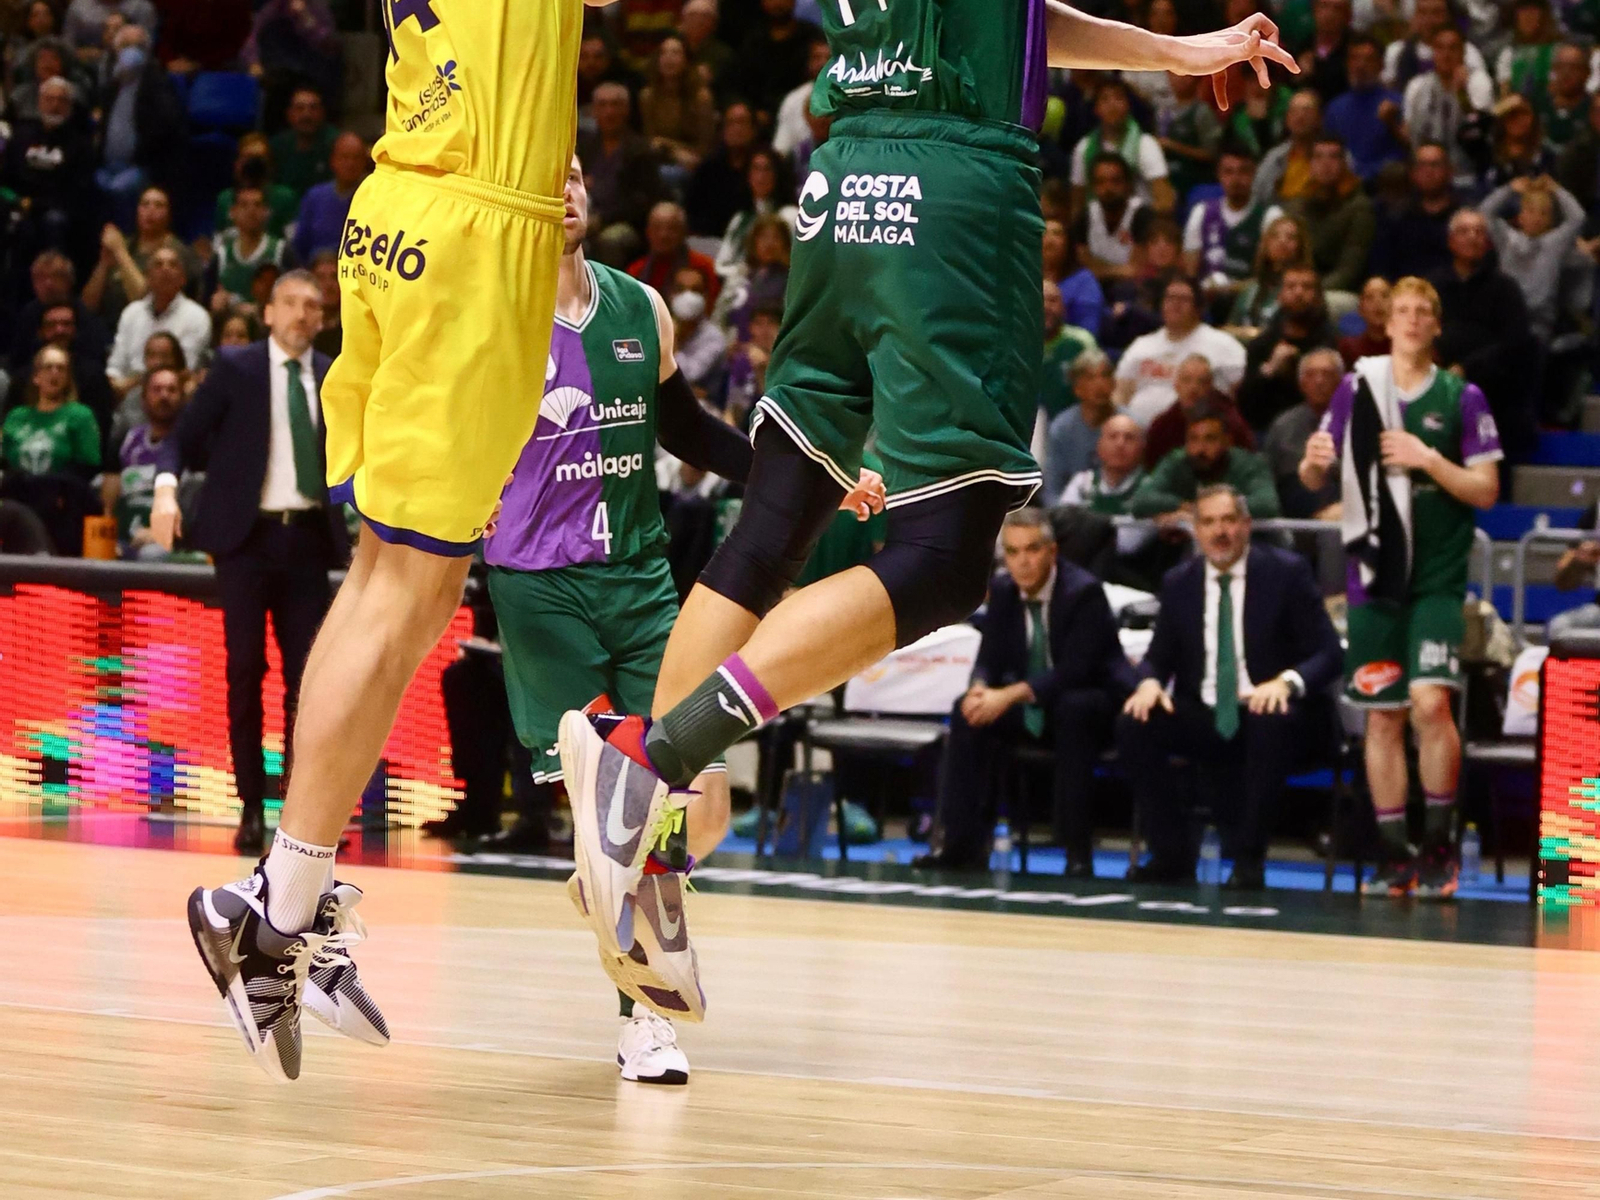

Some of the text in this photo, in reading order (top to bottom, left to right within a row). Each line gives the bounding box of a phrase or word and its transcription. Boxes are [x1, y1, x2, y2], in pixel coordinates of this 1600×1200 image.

[840, 174, 922, 200] COSTA
[835, 201, 870, 221] DEL
[873, 202, 919, 223] SOL
[833, 220, 915, 246] MÁLAGA
[589, 396, 646, 421] Unicaja
[591, 501, 613, 555] 4
[281, 837, 335, 859] SPALDIN
